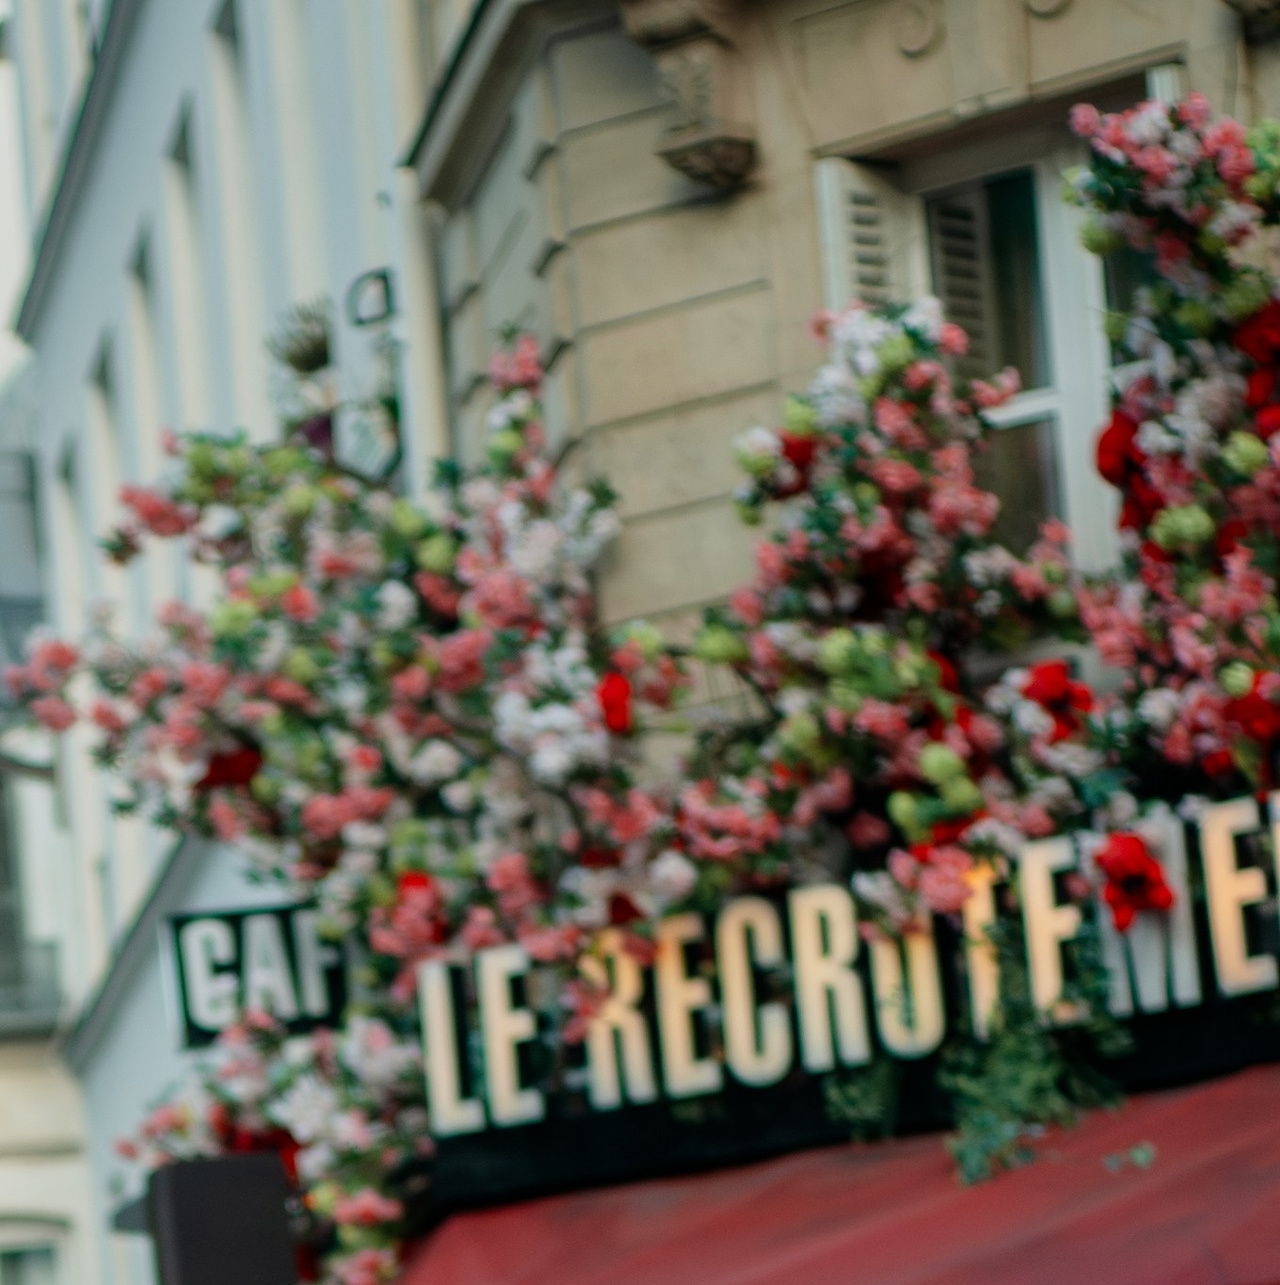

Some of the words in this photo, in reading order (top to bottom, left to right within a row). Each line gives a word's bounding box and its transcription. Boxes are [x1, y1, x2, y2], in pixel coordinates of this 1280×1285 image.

[179, 909, 360, 1032] CAF
[420, 945, 546, 1136] LE
[582, 790, 1280, 1112] RECRUTEME
